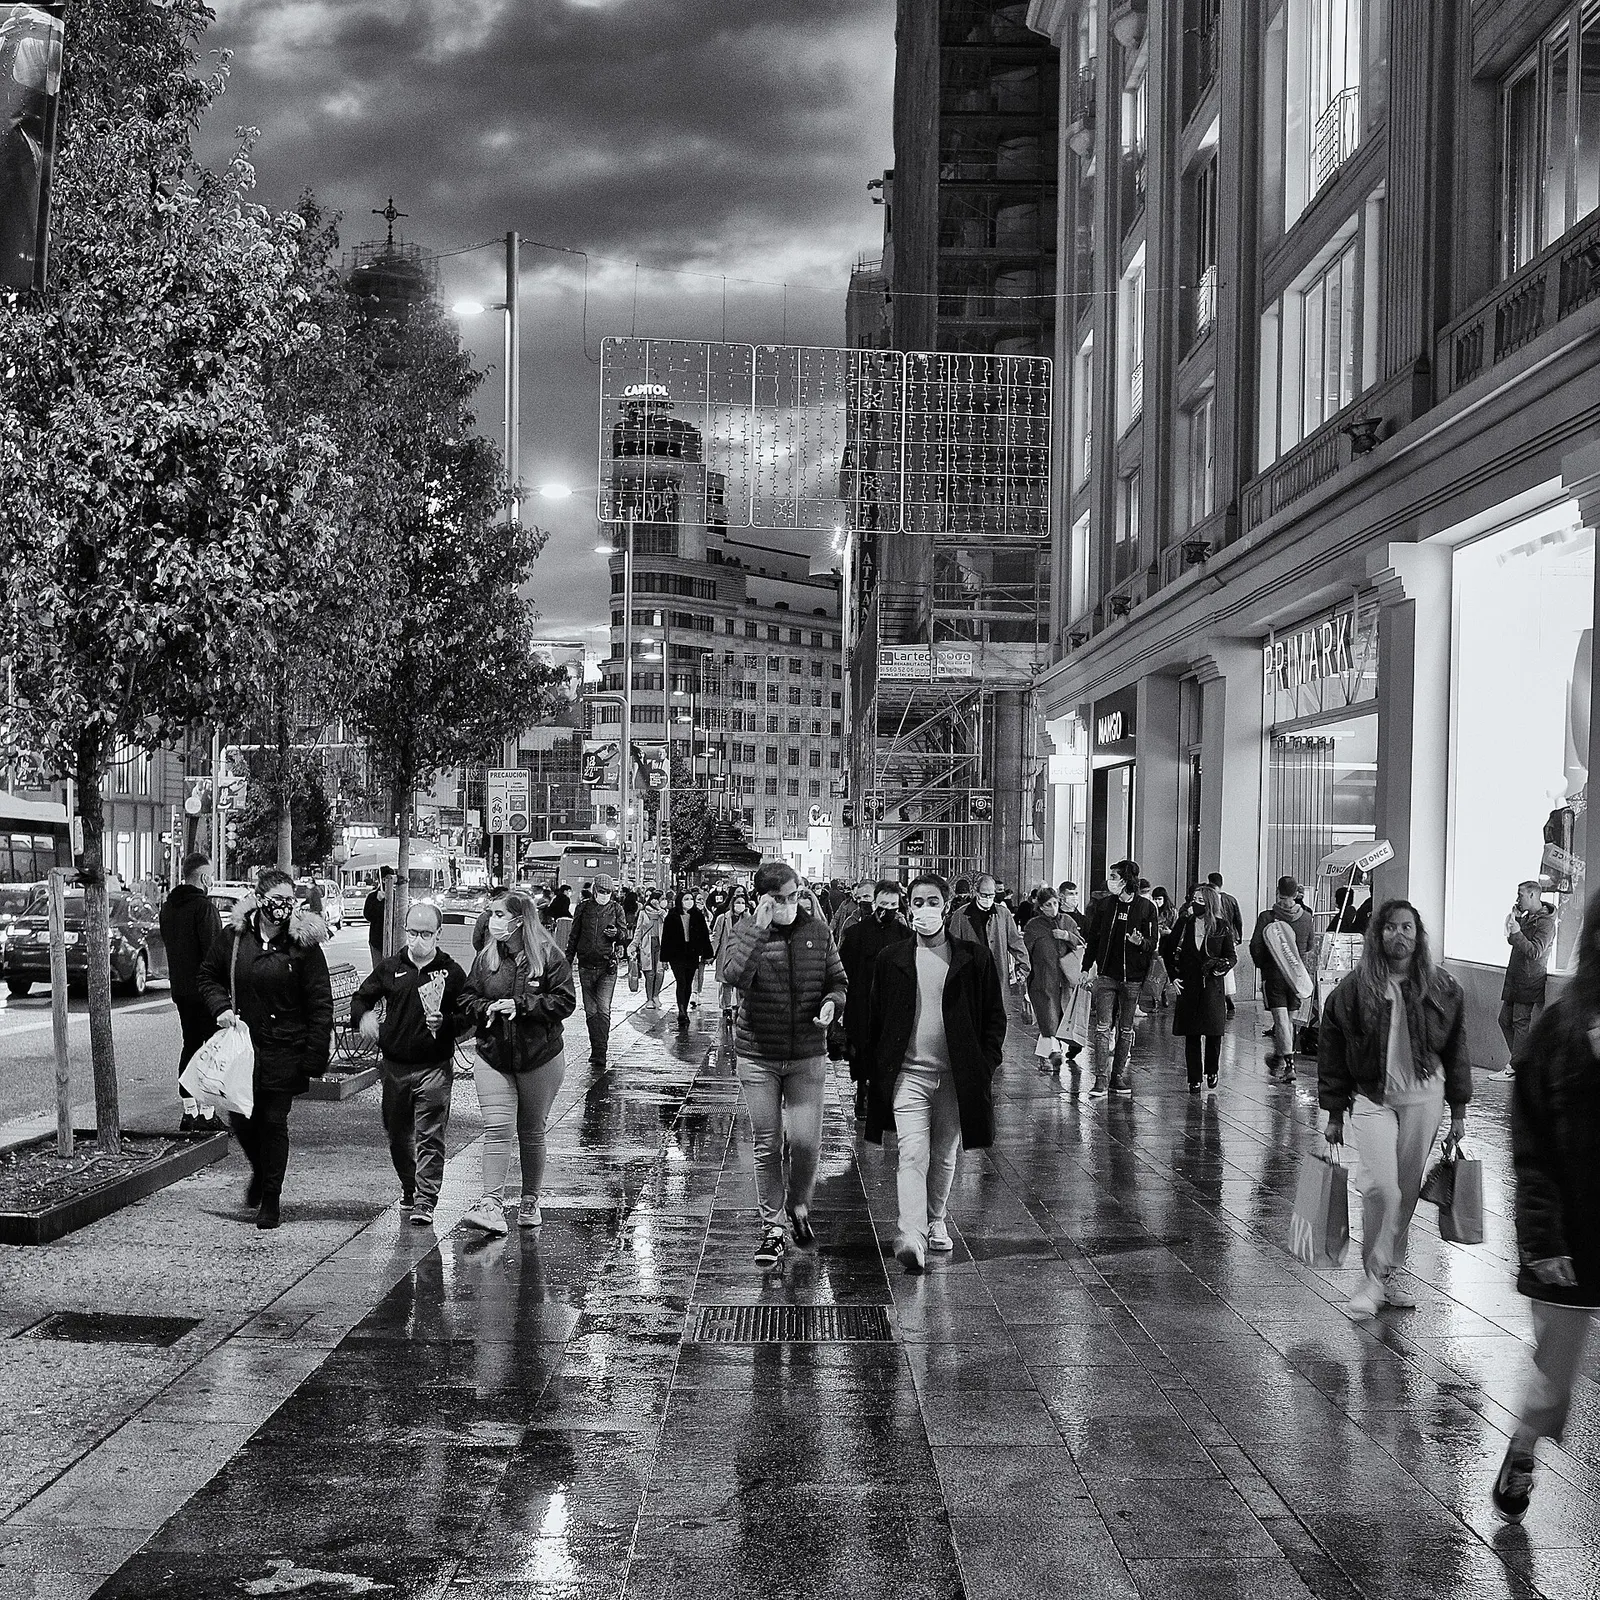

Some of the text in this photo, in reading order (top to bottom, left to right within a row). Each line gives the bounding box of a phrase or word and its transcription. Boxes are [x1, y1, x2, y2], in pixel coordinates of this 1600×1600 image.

[624, 384, 669, 397] CAPITOL
[894, 651, 931, 661] Lartec
[1263, 614, 1349, 695] PRIMARK
[1098, 711, 1122, 745] MANGO
[1368, 847, 1389, 863] ONCE
